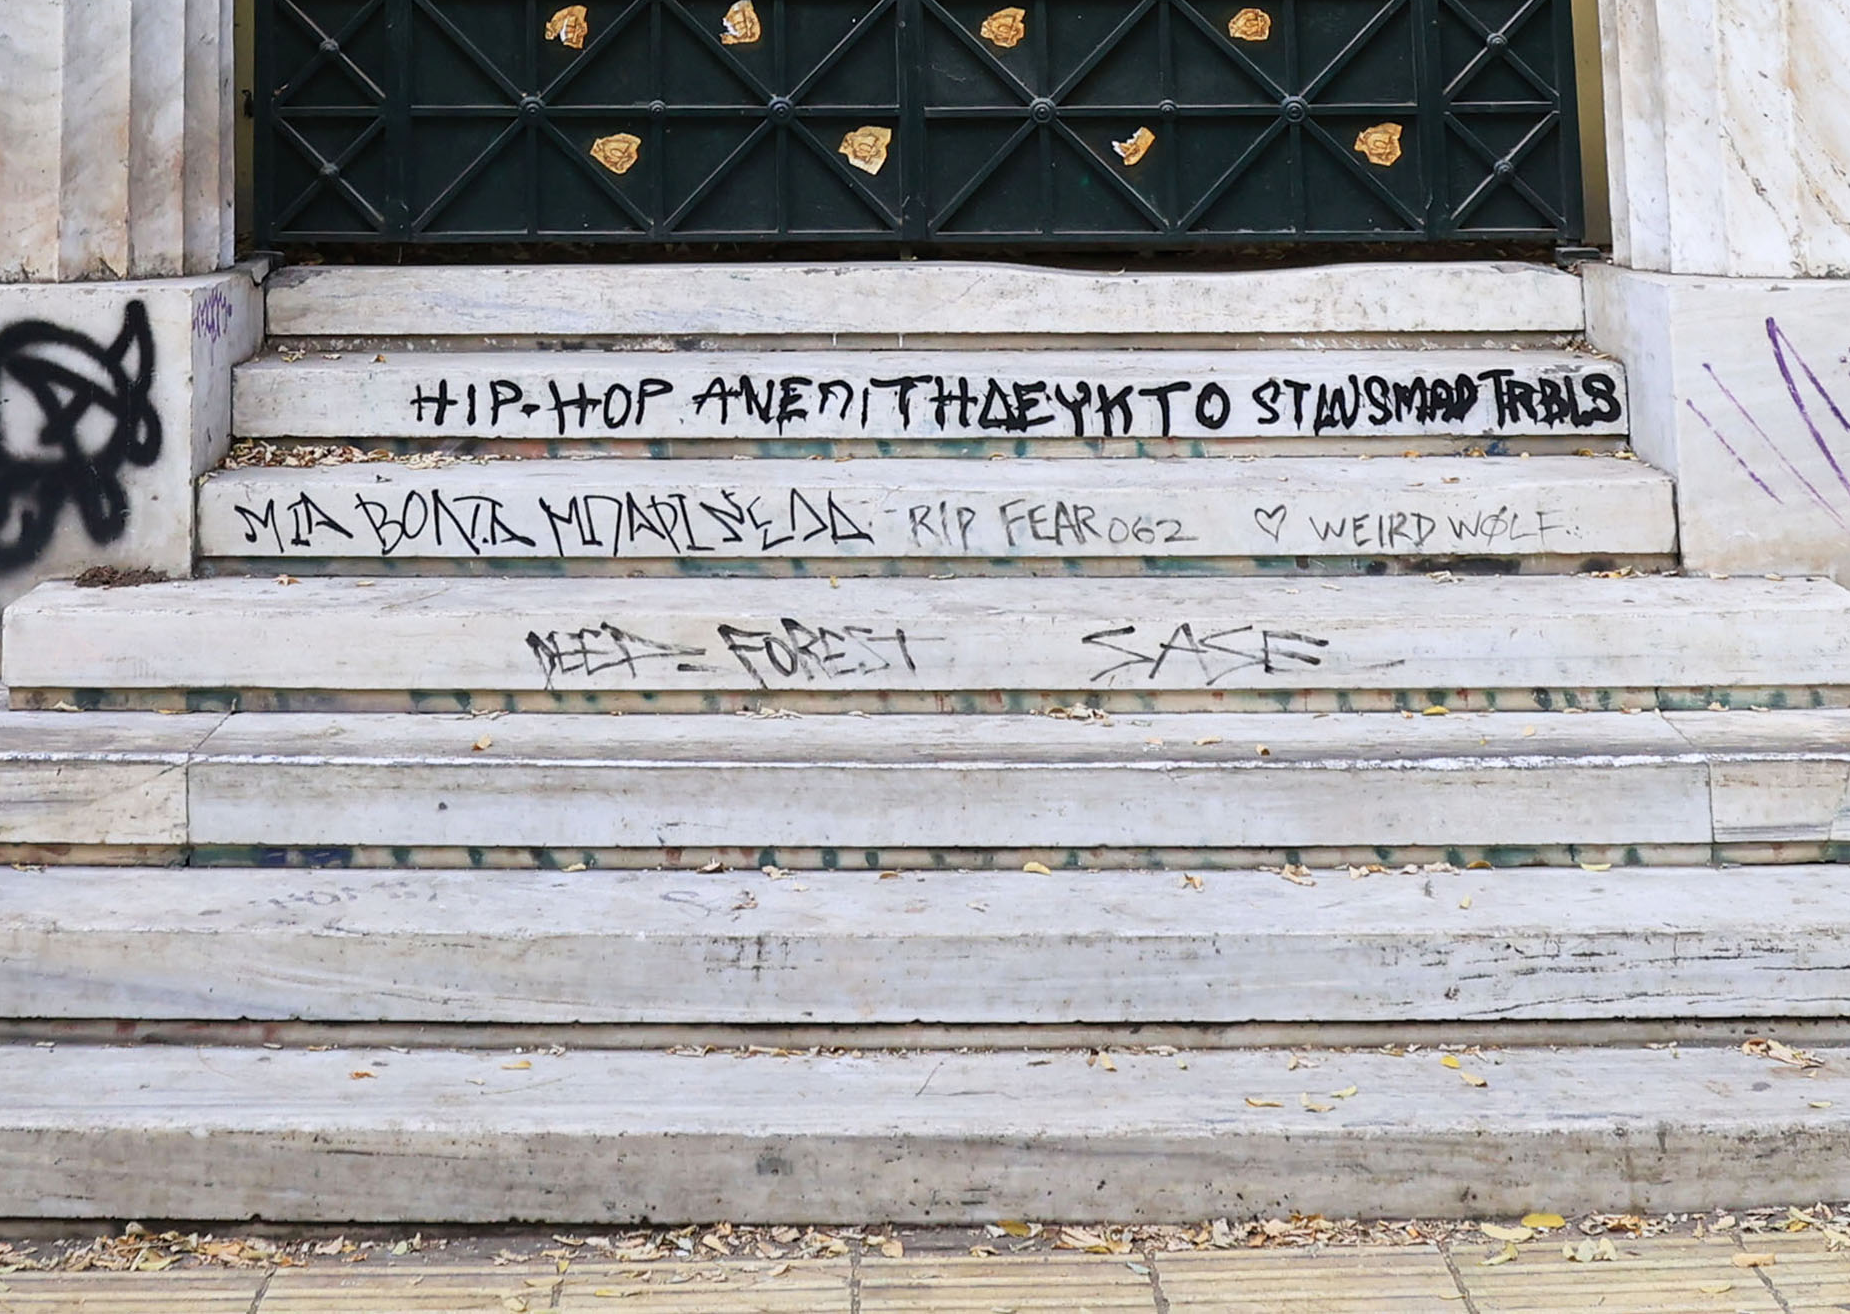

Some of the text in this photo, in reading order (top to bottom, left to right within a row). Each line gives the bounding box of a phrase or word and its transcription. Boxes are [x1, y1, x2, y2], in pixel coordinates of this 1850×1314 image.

[411, 377, 674, 435] HIP-HOP
[910, 499, 977, 551] RIP
[1309, 509, 1437, 549] WEIRD
